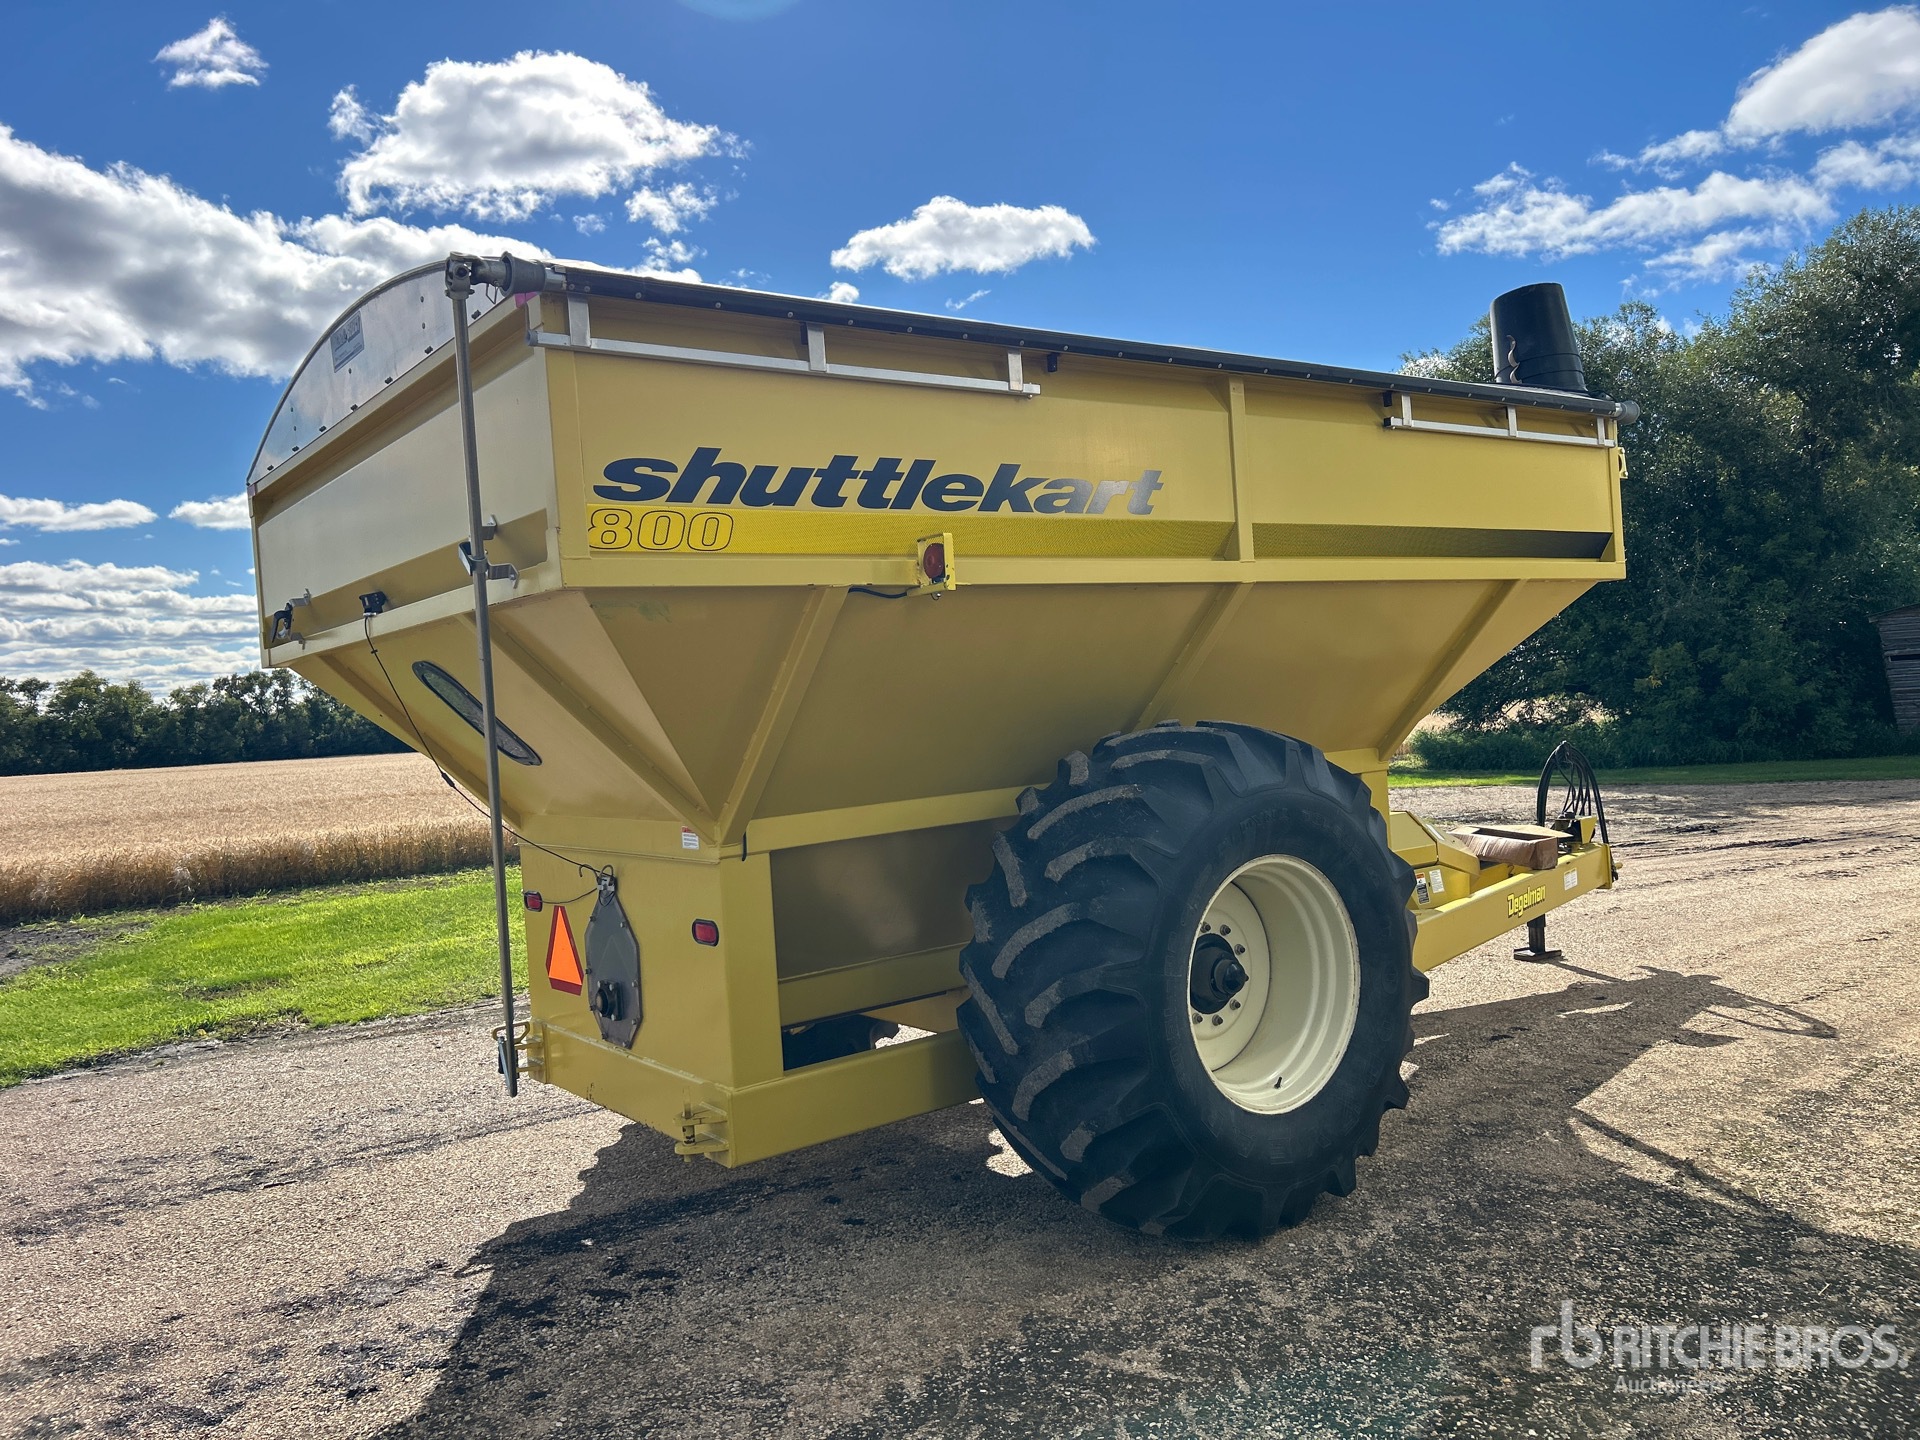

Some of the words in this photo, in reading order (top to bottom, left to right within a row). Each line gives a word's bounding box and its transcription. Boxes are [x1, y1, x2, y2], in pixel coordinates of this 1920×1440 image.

[593, 446, 1164, 515] shuttlekart
[588, 508, 734, 551] 800
[1507, 884, 1546, 918] Degelman
